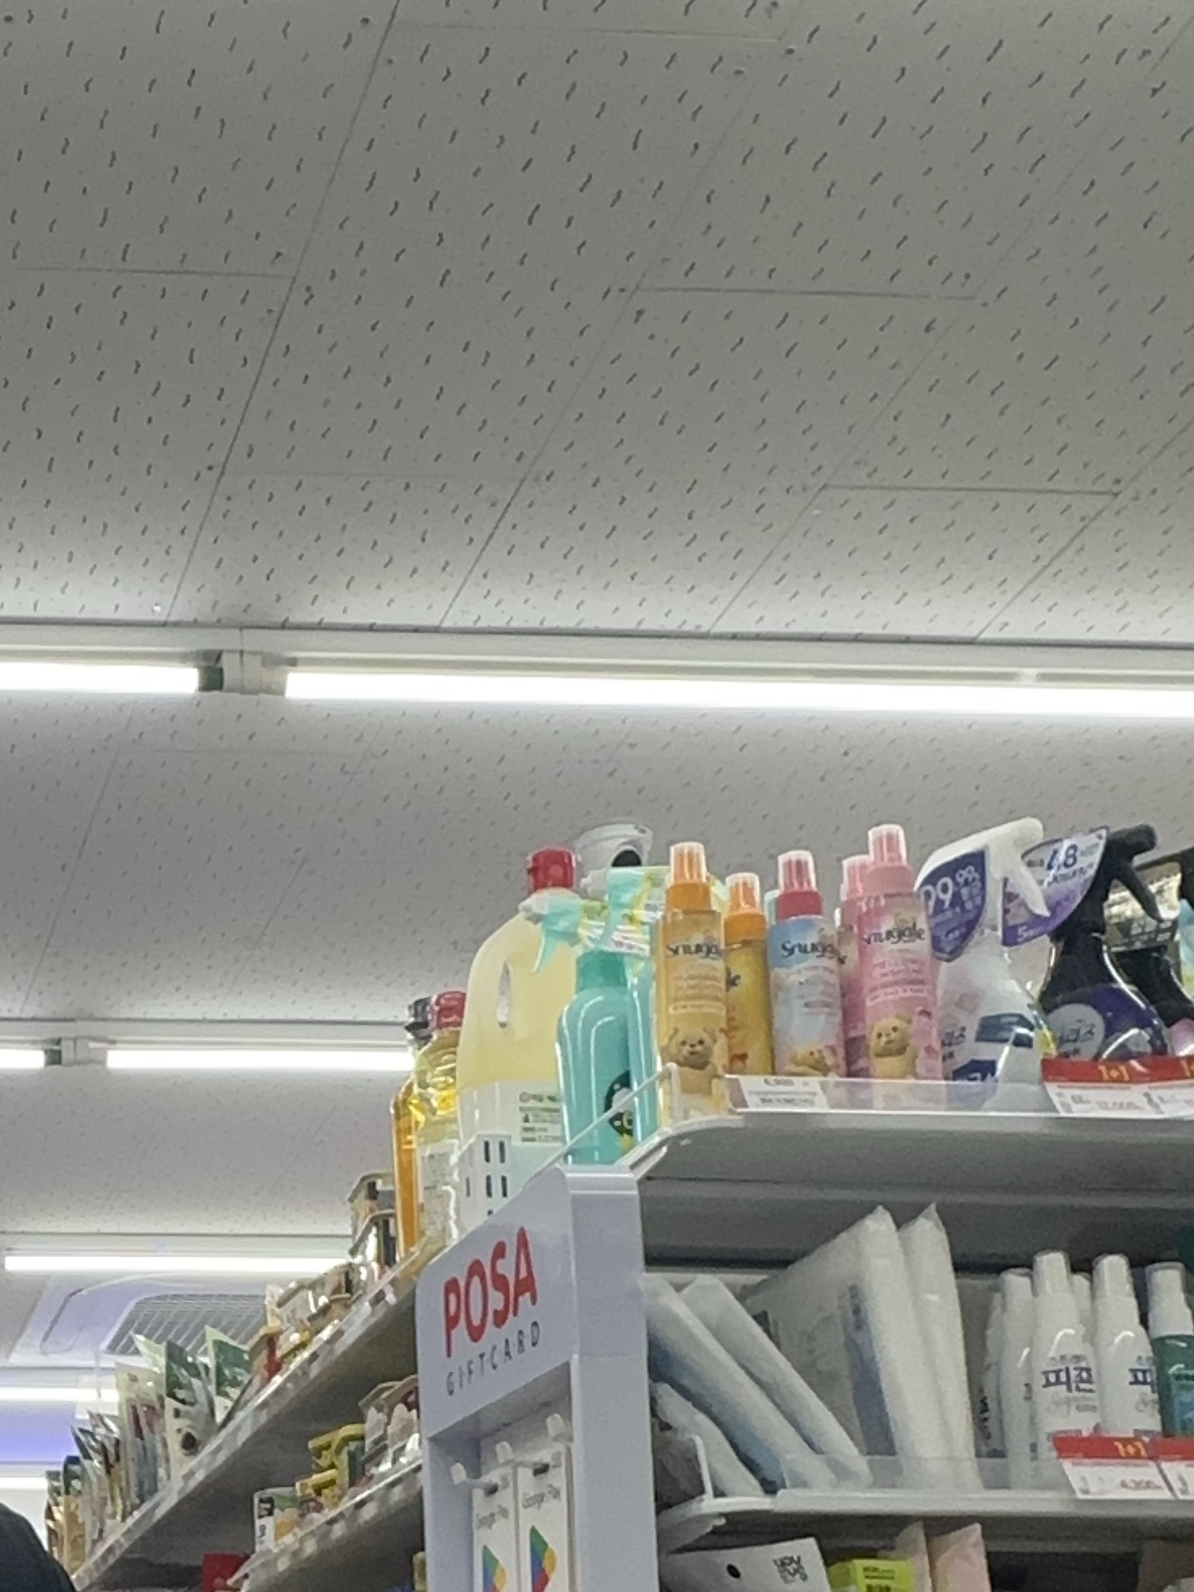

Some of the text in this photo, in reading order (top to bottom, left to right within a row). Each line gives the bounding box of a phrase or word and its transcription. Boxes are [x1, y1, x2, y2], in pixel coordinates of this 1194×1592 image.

[1098, 1064, 1130, 1081] 1+1
[443, 1225, 539, 1359] POSA
[1041, 1366, 1096, 1393] 피죤
[1128, 1367, 1156, 1394] 피
[1114, 1441, 1148, 1458] 1+1
